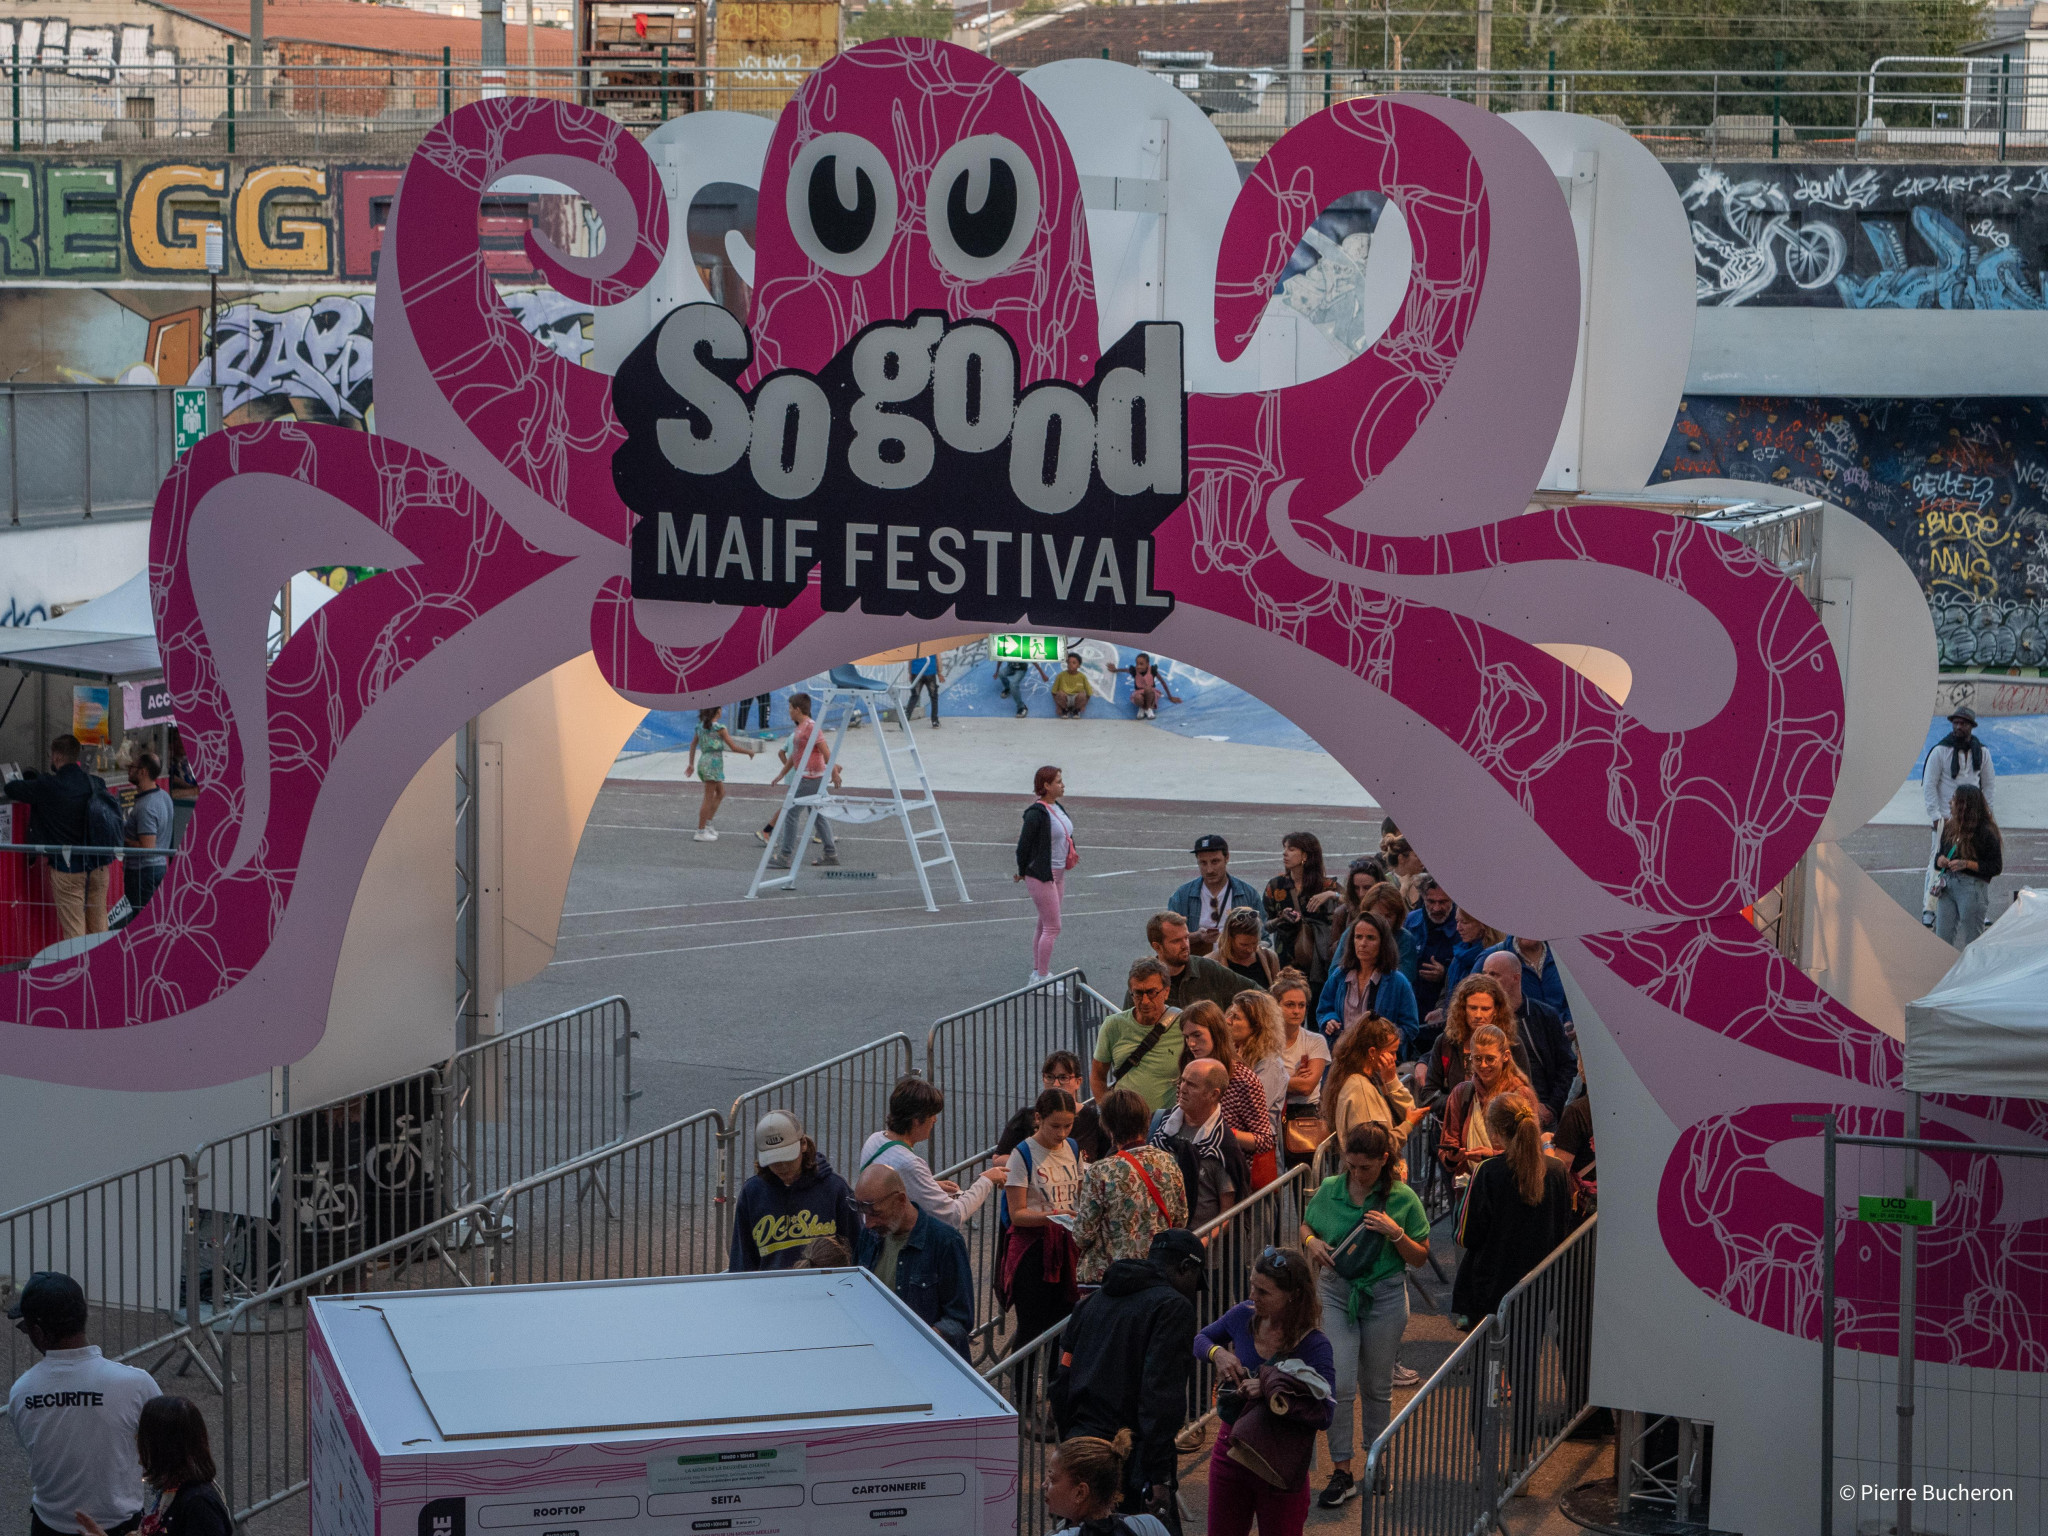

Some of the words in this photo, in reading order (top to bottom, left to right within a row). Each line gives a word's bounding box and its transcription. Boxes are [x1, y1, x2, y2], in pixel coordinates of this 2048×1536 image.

[656, 302, 831, 500] So
[848, 316, 1183, 515] good
[657, 511, 818, 584] MAIF
[845, 522, 1170, 607] FESTIVAL
[1881, 1198, 1907, 1209] UCD
[25, 1391, 104, 1410] SECURITE
[852, 1481, 927, 1495] CARTONNERIE
[711, 1494, 742, 1505] SEITA
[533, 1506, 586, 1518] ROOFTOP
